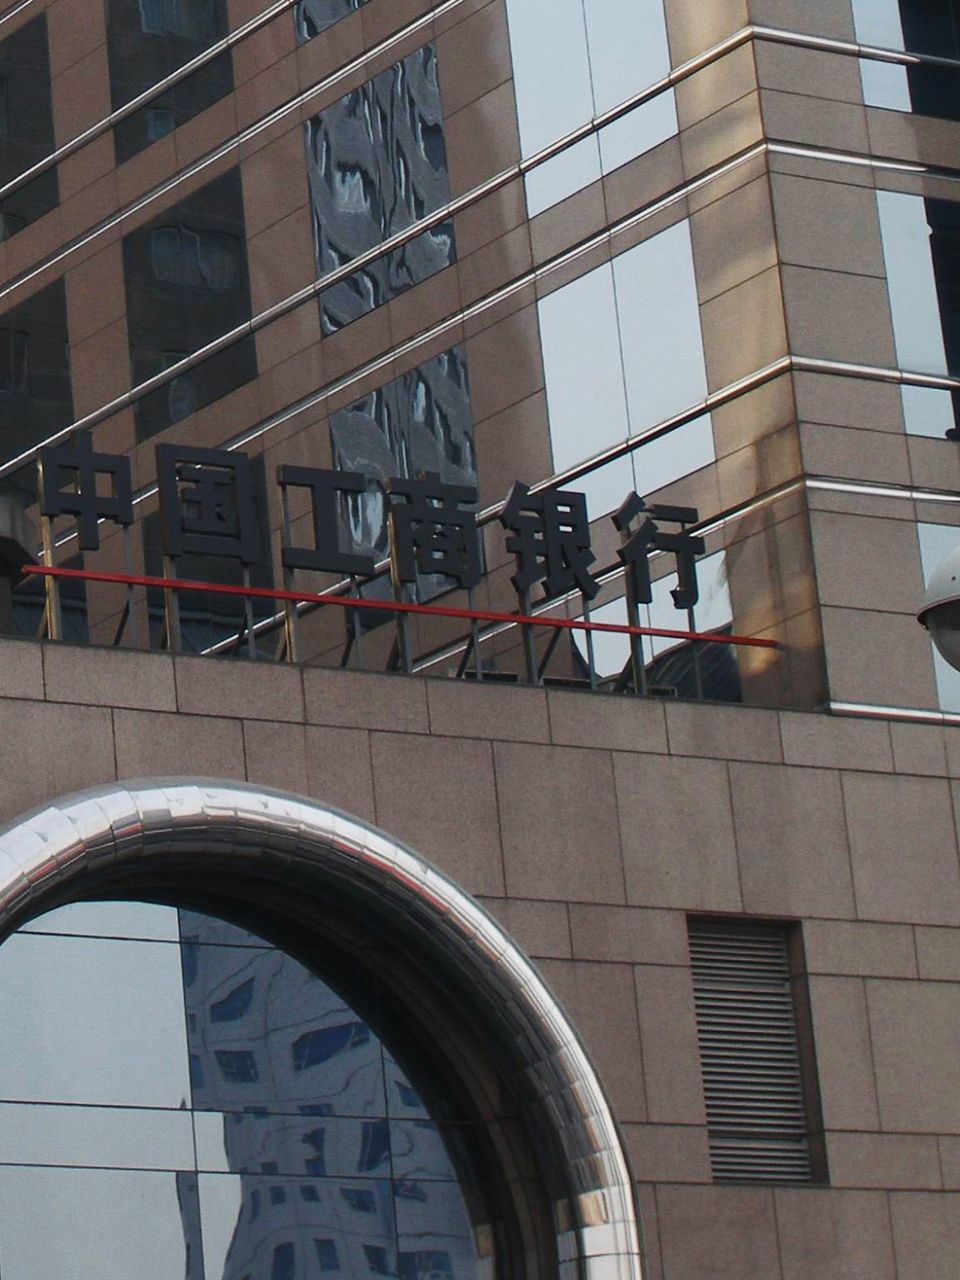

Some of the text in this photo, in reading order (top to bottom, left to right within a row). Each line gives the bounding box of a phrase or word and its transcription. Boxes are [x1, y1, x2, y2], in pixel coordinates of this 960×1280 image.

[40, 429, 706, 609] 中国工商银行
